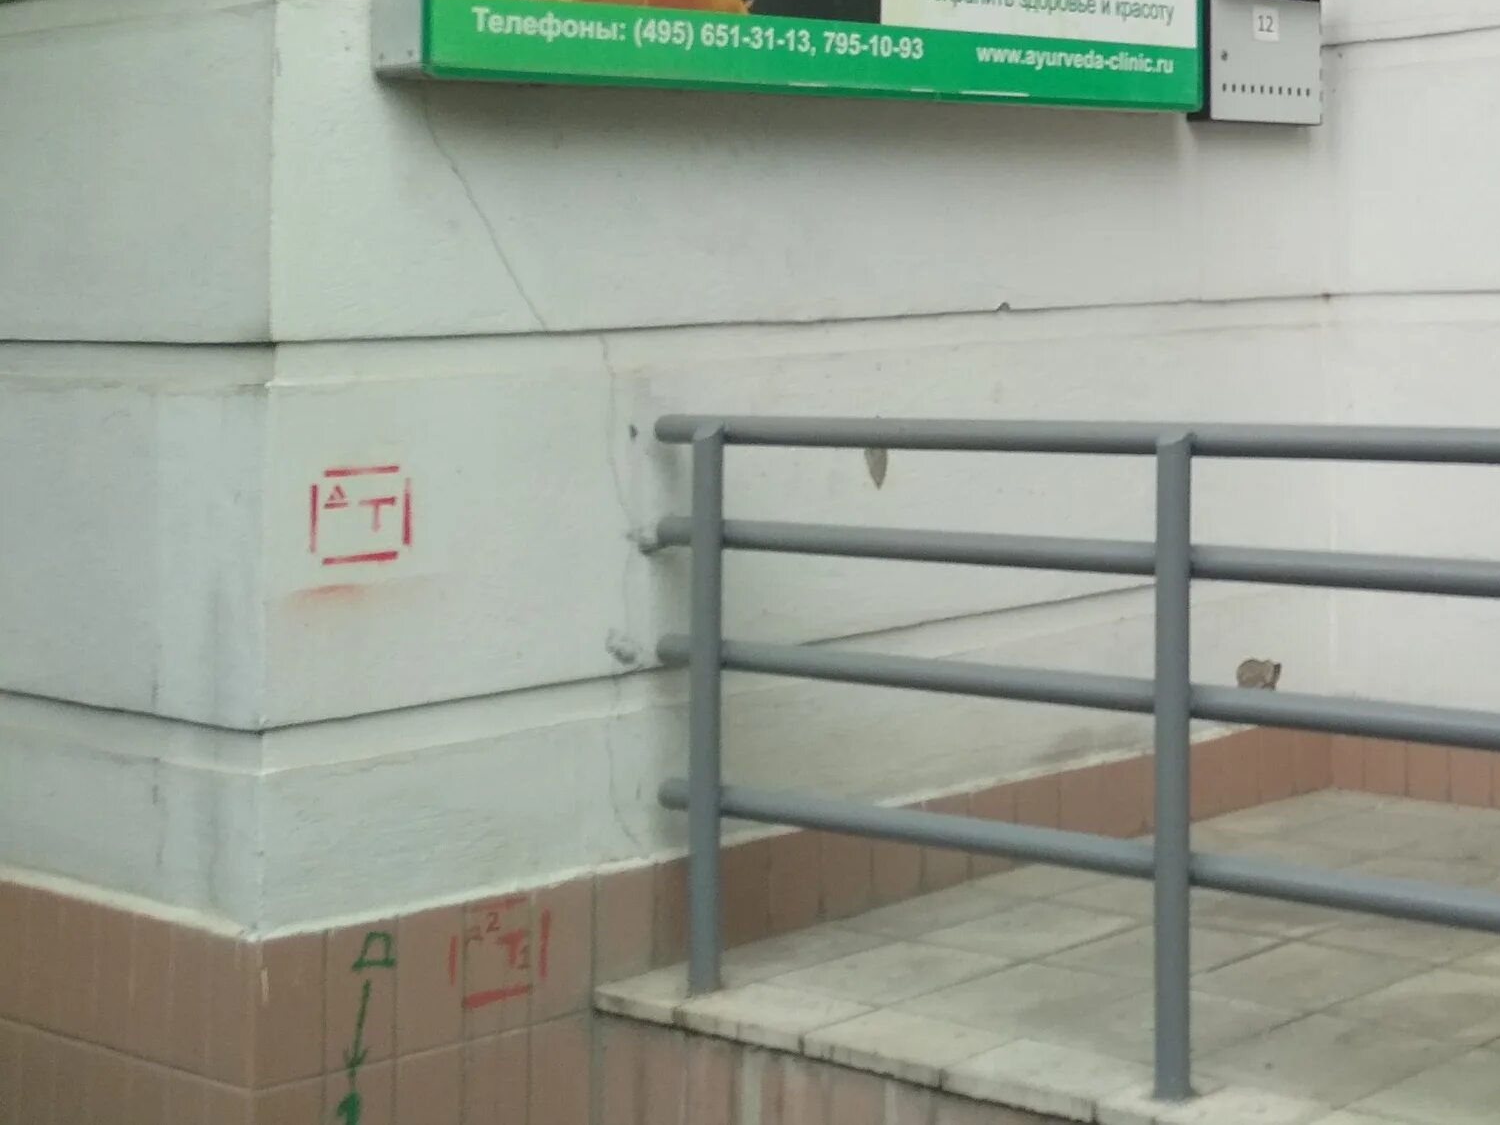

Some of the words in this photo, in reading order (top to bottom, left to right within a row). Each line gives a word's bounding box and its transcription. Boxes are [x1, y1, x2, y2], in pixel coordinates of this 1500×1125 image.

[1101, 0, 1112, 14] и
[1116, 0, 1174, 26] красоту
[1257, 15, 1275, 32] 12
[471, 5, 626, 43] Телефоны:
[634, 17, 694, 50] (495)
[701, 18, 817, 57] 651-31-13,
[823, 31, 924, 60] 795-10-93
[976, 45, 1173, 74] www.ayurveda-clinic.ru
